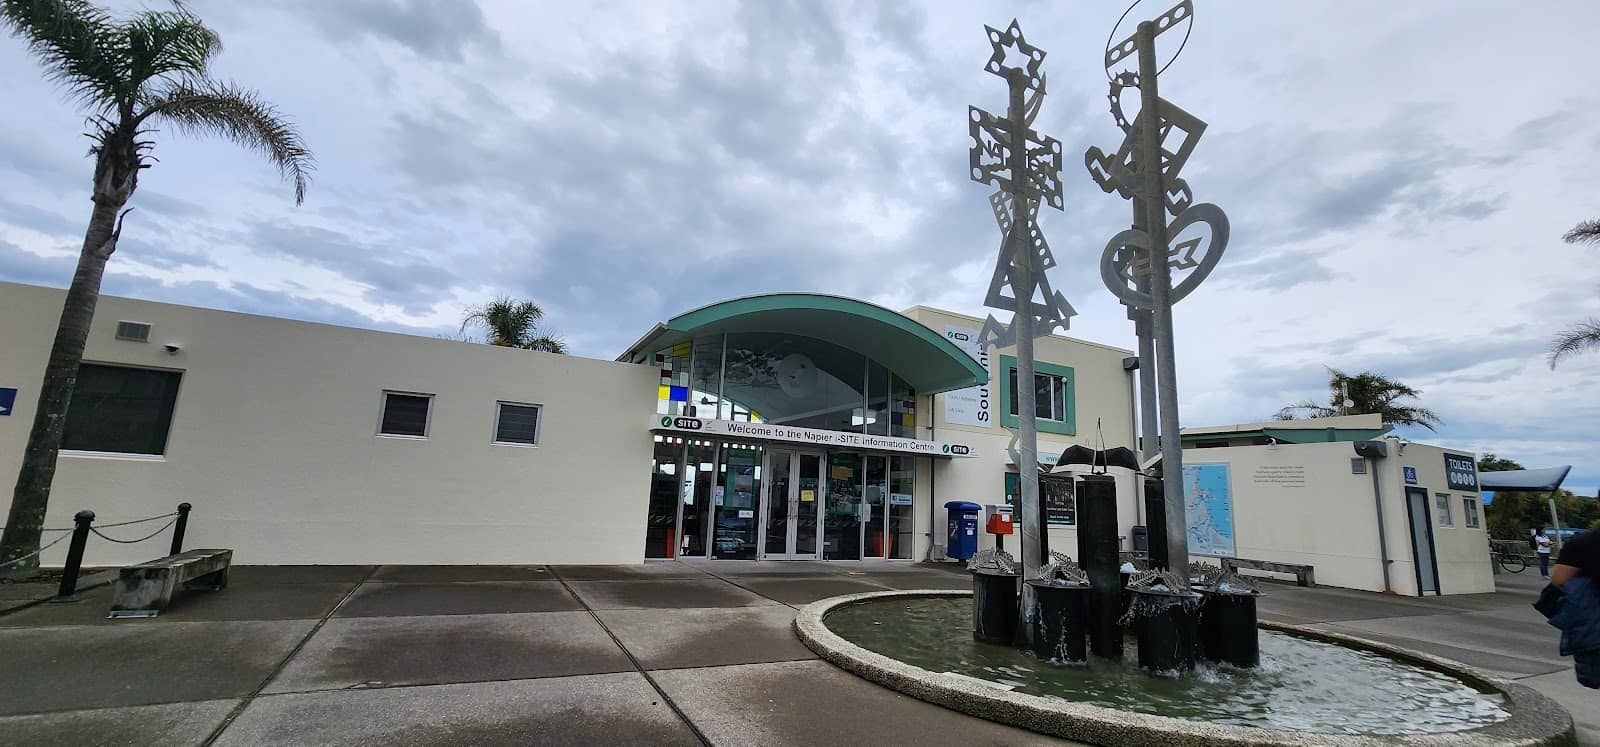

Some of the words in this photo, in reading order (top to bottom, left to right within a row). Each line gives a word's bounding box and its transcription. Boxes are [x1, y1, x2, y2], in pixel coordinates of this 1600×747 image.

[677, 419, 699, 428] SITE
[727, 423, 771, 436] Welcome
[775, 429, 784, 438] to
[787, 430, 802, 439] the
[804, 431, 833, 442] Napier
[834, 434, 860, 445] i-SITE
[862, 437, 908, 450] Information
[910, 441, 935, 451] Centre
[1448, 459, 1473, 472] TOILETS
